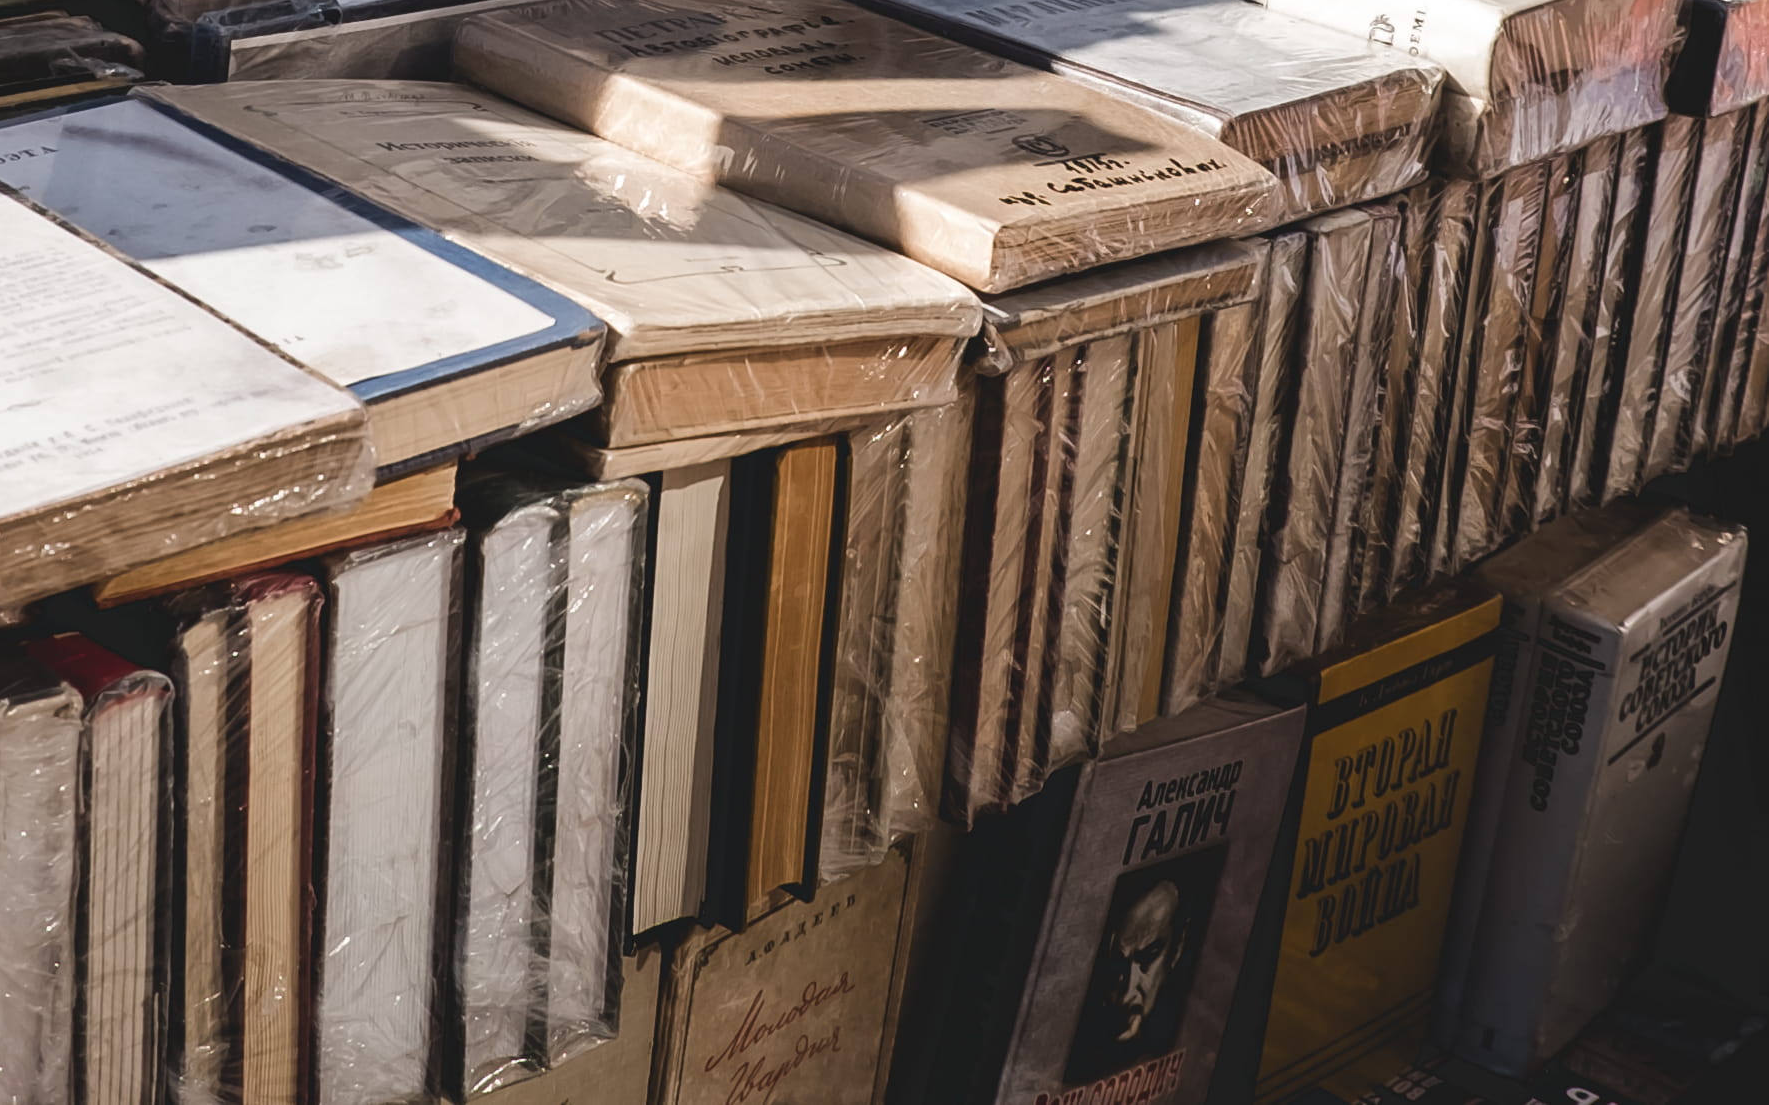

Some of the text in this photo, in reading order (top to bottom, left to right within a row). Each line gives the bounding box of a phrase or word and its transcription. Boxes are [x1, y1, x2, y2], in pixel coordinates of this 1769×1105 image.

[1136, 759, 1244, 812] Александр
[1326, 707, 1458, 821] ВТОРАЯ
[1121, 790, 1237, 866] ГАЛИЧ
[1295, 769, 1462, 900] МИРОВАЯ
[1309, 851, 1421, 958] ВОЙНА
